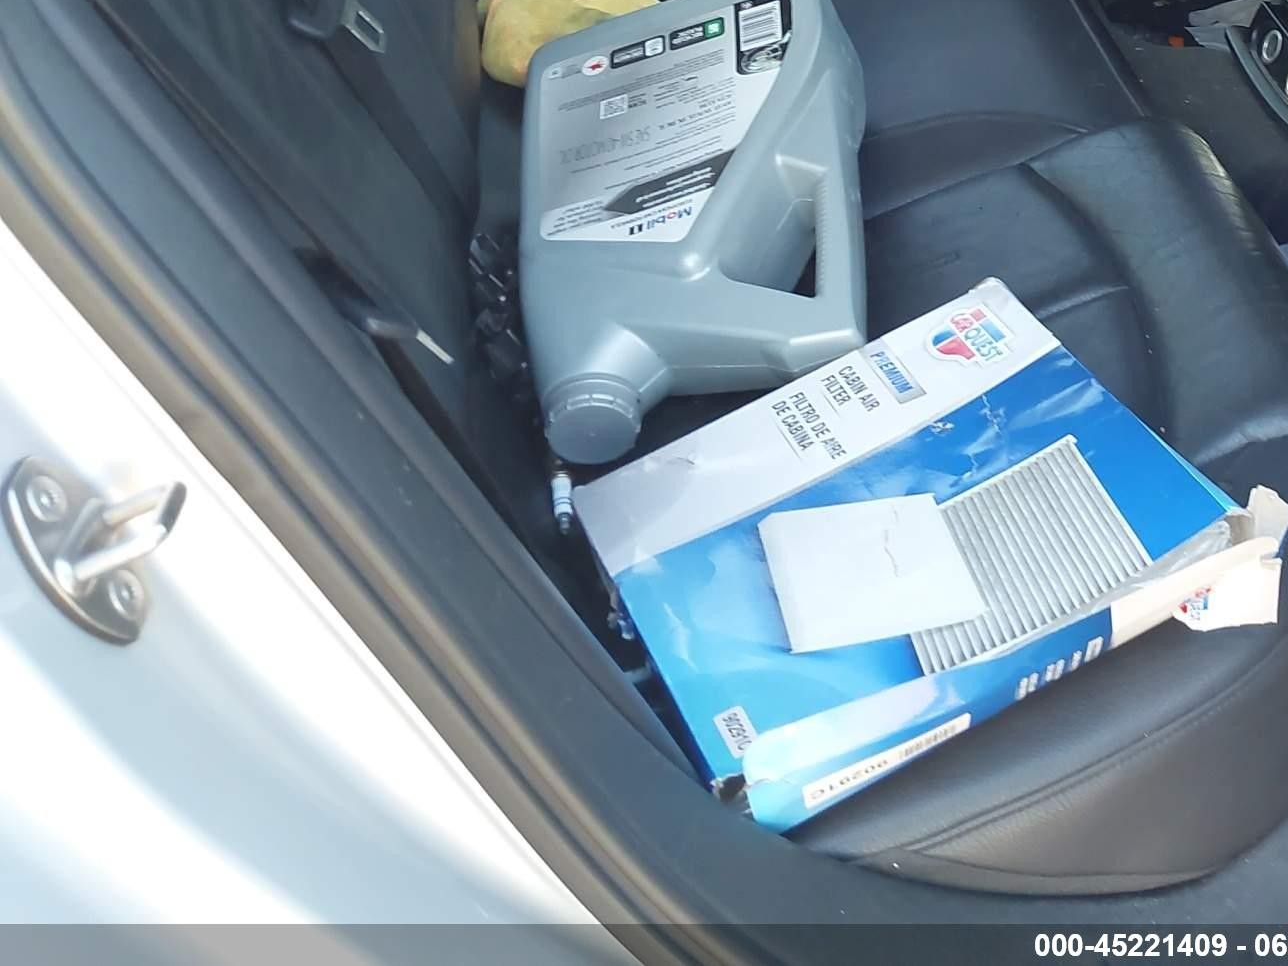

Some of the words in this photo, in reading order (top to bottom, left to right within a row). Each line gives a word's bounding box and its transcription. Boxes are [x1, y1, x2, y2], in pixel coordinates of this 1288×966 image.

[646, 206, 692, 230] Mobil
[820, 374, 852, 407] FILTER
[838, 365, 867, 396] CABIN
[860, 392, 881, 413] AIR
[870, 351, 914, 394] PREMIUM
[772, 400, 792, 416] DE
[789, 391, 821, 426] FILTRO
[811, 421, 831, 439] DE
[821, 437, 848, 460] AIRE
[781, 414, 815, 451] CABINA
